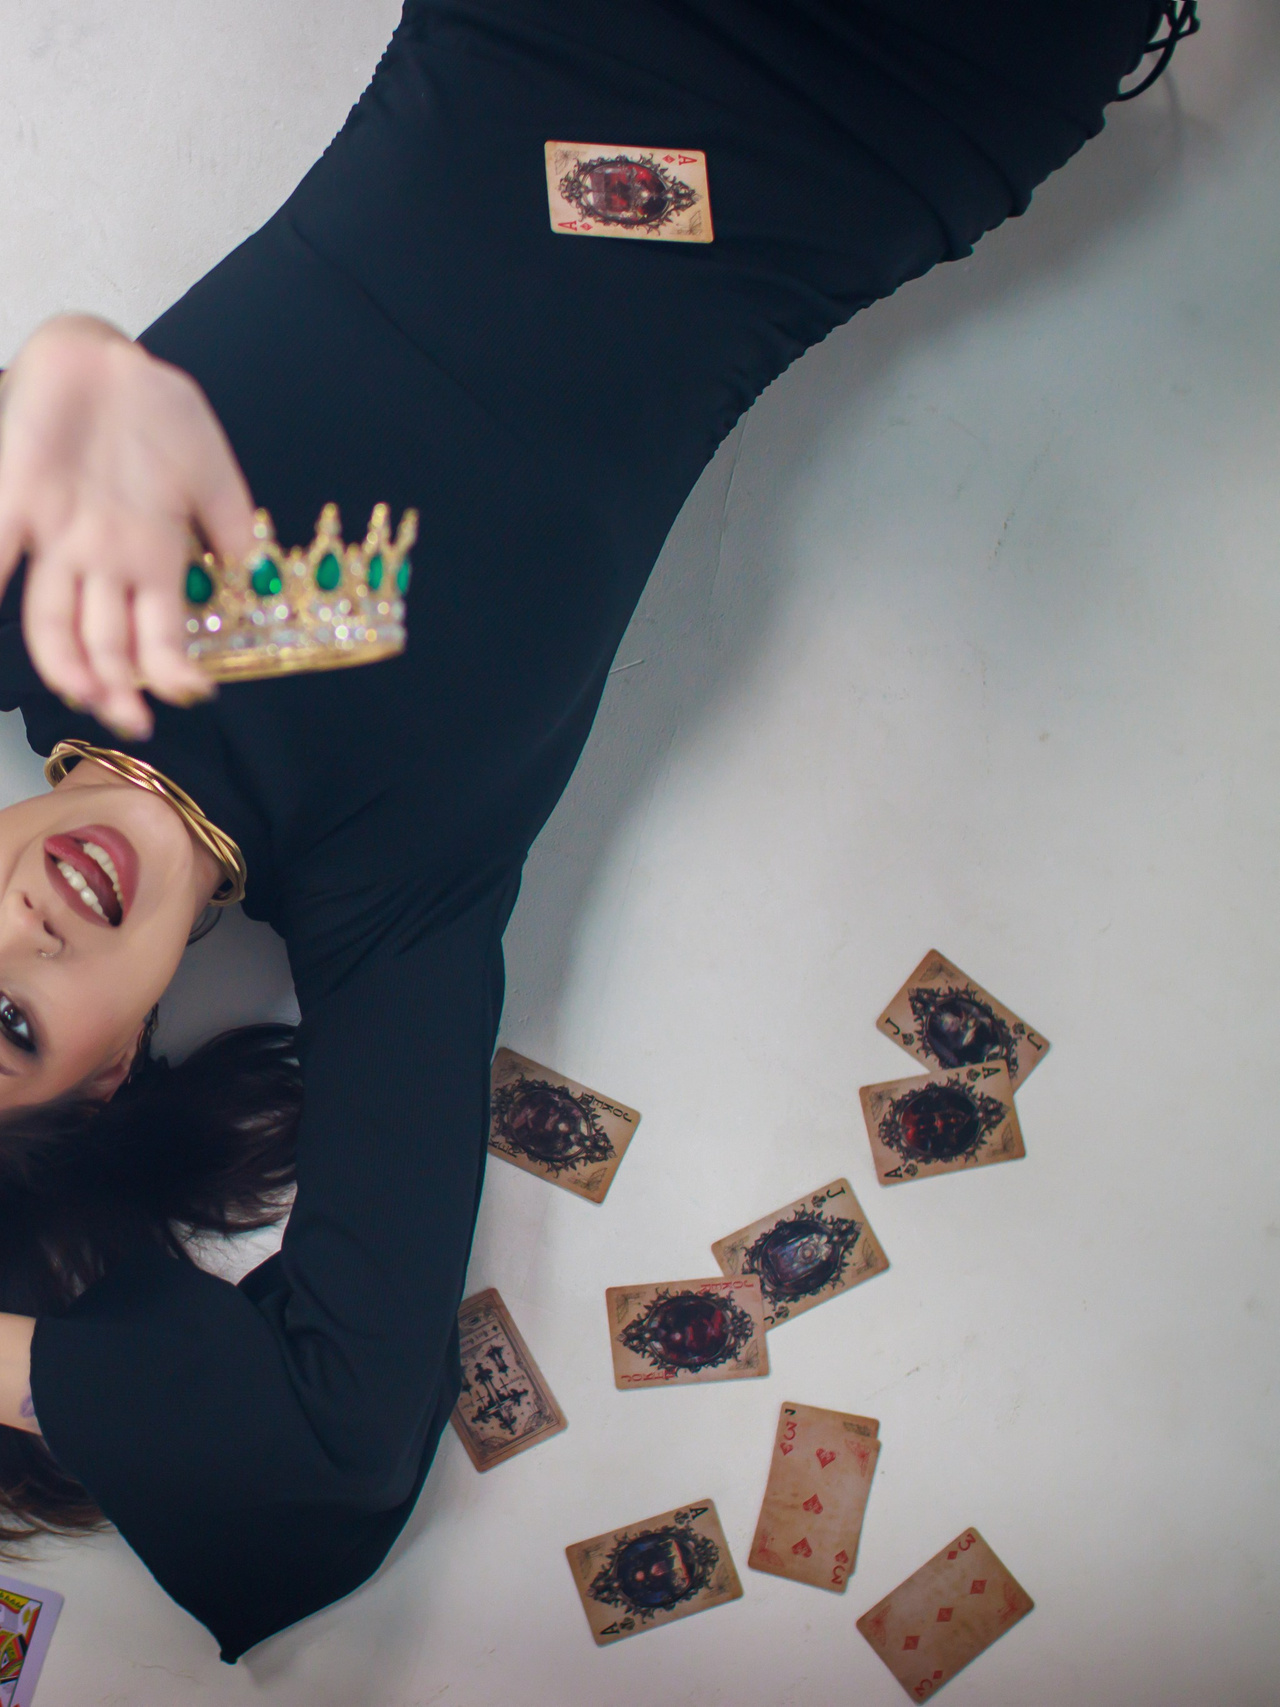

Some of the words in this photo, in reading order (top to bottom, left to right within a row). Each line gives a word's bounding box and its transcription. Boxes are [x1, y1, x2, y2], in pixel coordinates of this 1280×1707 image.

[678, 154, 698, 165] A
[557, 220, 577, 231] A
[885, 1017, 900, 1035] J
[1027, 1033, 1042, 1051] J
[982, 1066, 1001, 1079] A
[884, 1166, 903, 1178] A
[827, 1187, 845, 1198] J
[784, 1421, 797, 1440] 3
[689, 1507, 709, 1520] A
[957, 1532, 976, 1551] 3
[831, 1565, 845, 1585] 3
[600, 1621, 619, 1635] A
[913, 1678, 933, 1697] 3
